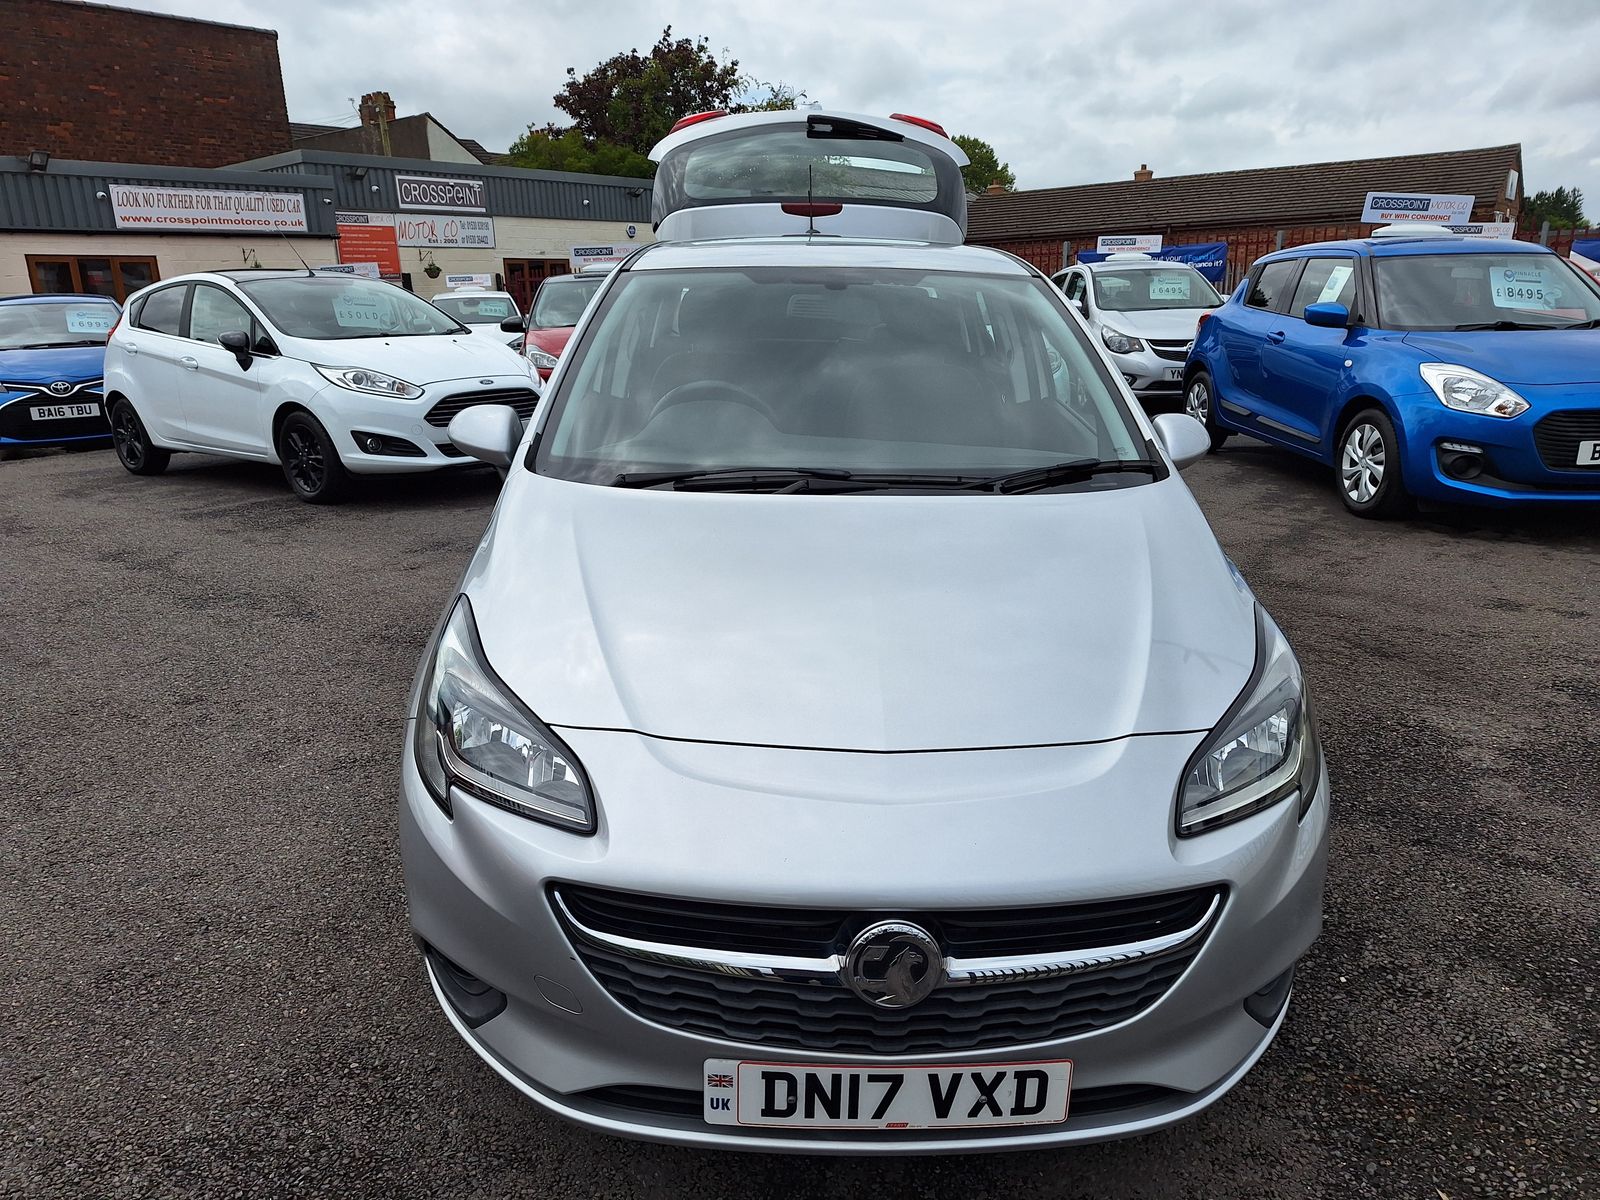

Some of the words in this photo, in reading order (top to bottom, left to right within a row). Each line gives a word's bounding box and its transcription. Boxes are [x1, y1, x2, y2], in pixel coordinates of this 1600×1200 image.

[402, 183, 481, 205] CROSSPOINT
[117, 191, 141, 207] LOOK
[143, 193, 155, 207] NO
[157, 193, 194, 209] FURTHER
[196, 195, 212, 210] FOR
[213, 196, 232, 210] THAT
[234, 197, 265, 214] QUALITY
[267, 198, 285, 212] USED
[287, 199, 301, 213] CAR
[1372, 198, 1430, 210] CROSSPOINT
[1431, 201, 1456, 209] MOTOR
[1457, 202, 1467, 210] CO
[120, 216, 304, 227] www.crosspointmotorcoco.uk
[399, 220, 438, 240] MOTOR
[444, 220, 459, 238] CO
[1189, 253, 1207, 262] Found
[38, 407, 65, 418] BA16
[68, 405, 92, 415] TBU
[760, 1070, 905, 1120] DN17
[928, 1069, 1048, 1118] VXD
[711, 1097, 731, 1111] UK
